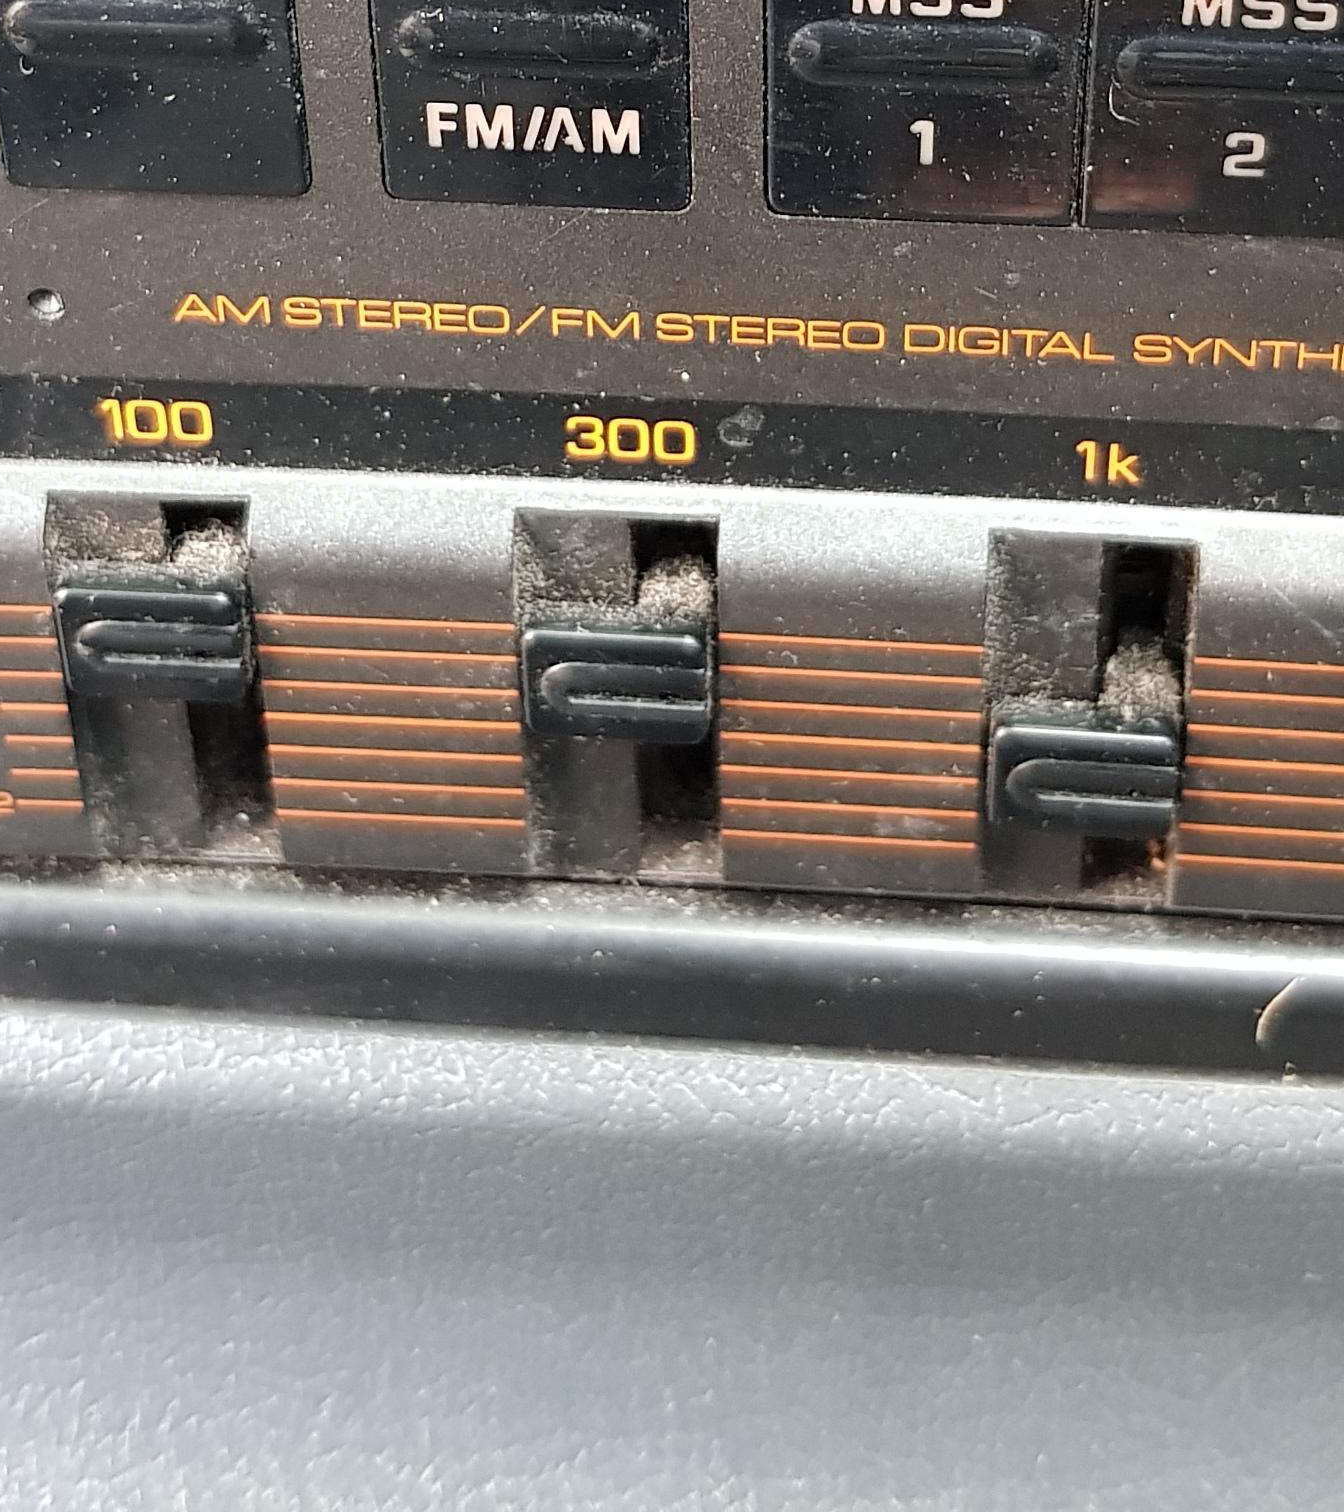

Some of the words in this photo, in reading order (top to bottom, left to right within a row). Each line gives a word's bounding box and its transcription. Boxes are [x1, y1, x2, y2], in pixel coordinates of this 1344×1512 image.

[424, 102, 644, 158] FM/AM
[1220, 130, 1270, 180] 2
[654, 314, 886, 354] STEREO
[904, 322, 1116, 364] DIGITAL
[98, 398, 214, 448] 100
[564, 416, 698, 468] 300
[1074, 440, 1144, 486] 1k
